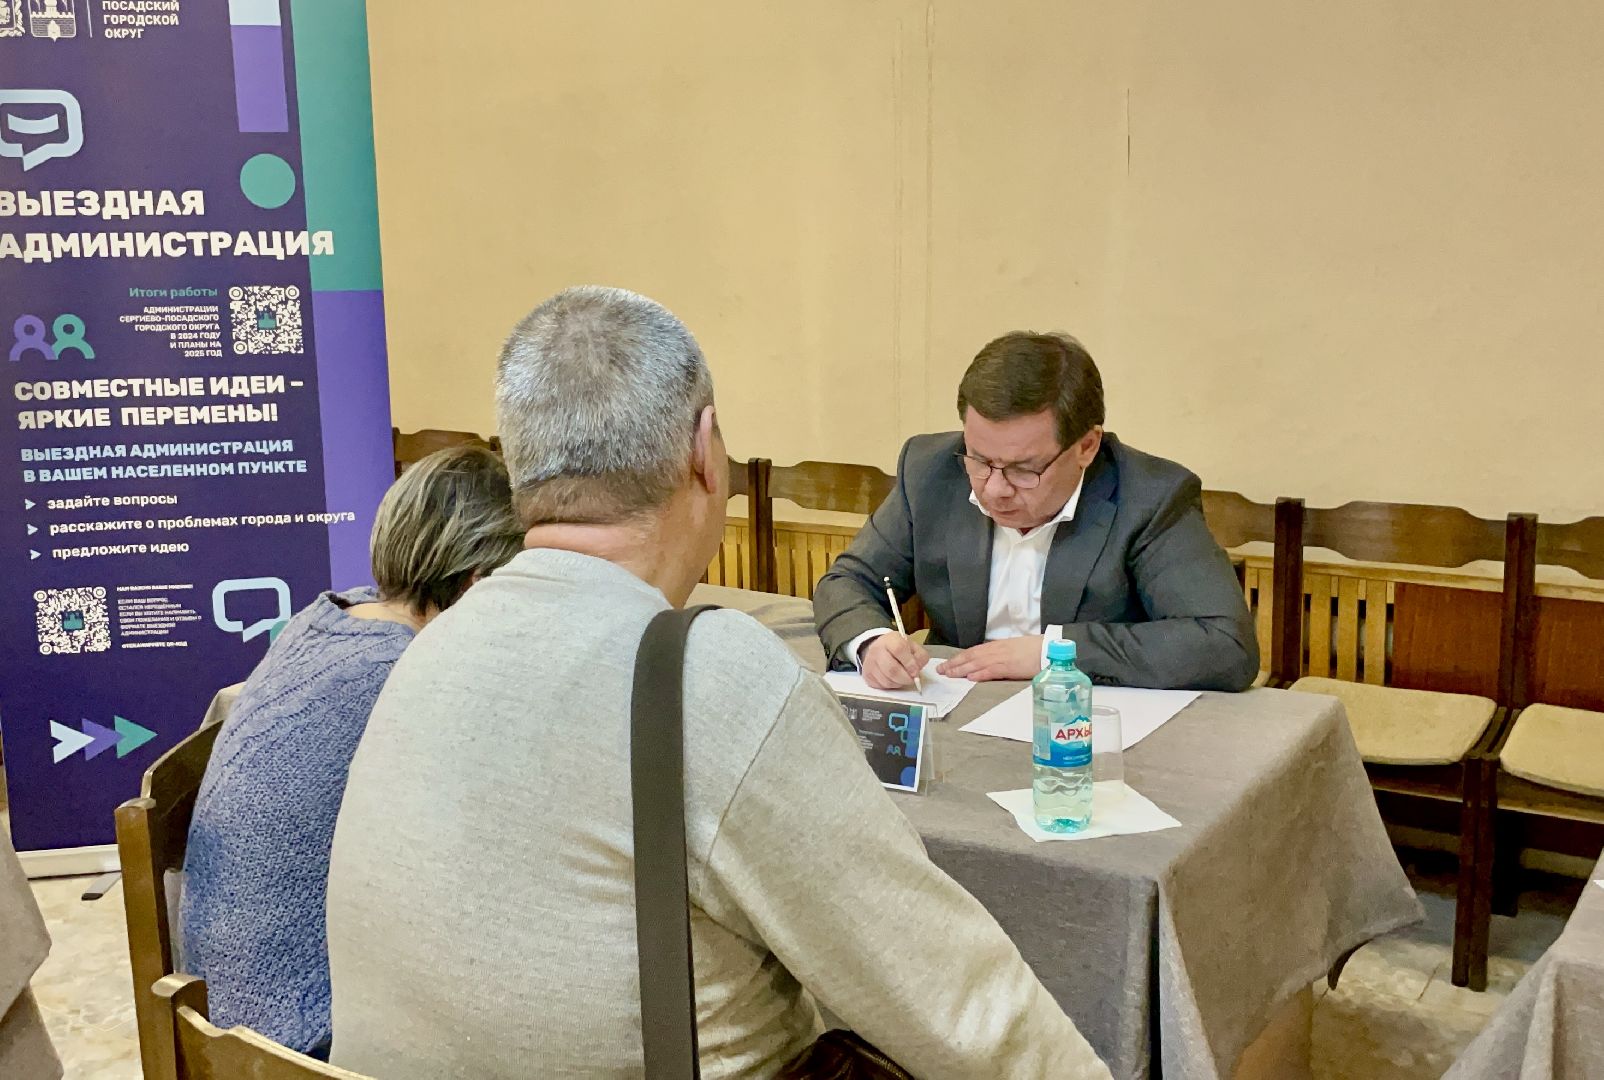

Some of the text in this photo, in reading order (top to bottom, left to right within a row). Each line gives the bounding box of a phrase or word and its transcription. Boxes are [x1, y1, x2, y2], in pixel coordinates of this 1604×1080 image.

[101, 0, 180, 13] ПОСАДСКИЙ
[103, 13, 180, 27] ГОРОДСКОЙ
[104, 28, 144, 39] ОКРУГ
[0, 190, 205, 220] ВЫЕЗДНАЯ
[0, 230, 335, 263] АДМИНИСТРАЦИЯ
[129, 287, 218, 300] Итоги работы
[120, 314, 219, 322] СЕРГИЕВО-ПОСАДСКОГО
[134, 323, 220, 332] ГОРОДСКОГО ОКРУГА
[170, 332, 176, 340] В
[199, 331, 221, 340] ГОДУ
[169, 340, 222, 349] И ПЛАНЫ НА
[14, 376, 205, 401] СОВМЕСТНЫЕ
[209, 374, 285, 398] ИДЕИ
[17, 403, 279, 430] ЯРКИЕ ПЕРЕМЕНЫ!
[20, 439, 294, 462] ВЫЕЗДНАЯ АДМИНИСТРАЦИЯ
[23, 459, 307, 483] В ВАШЕМ НАСЕЛЕННОМ ПУНКТЕ
[47, 492, 178, 511] задайте вопросы
[49, 510, 356, 536] расскажите о проблемах города и округа
[52, 540, 190, 560] предложите идею
[1055, 726, 1091, 740] АРХЫ
